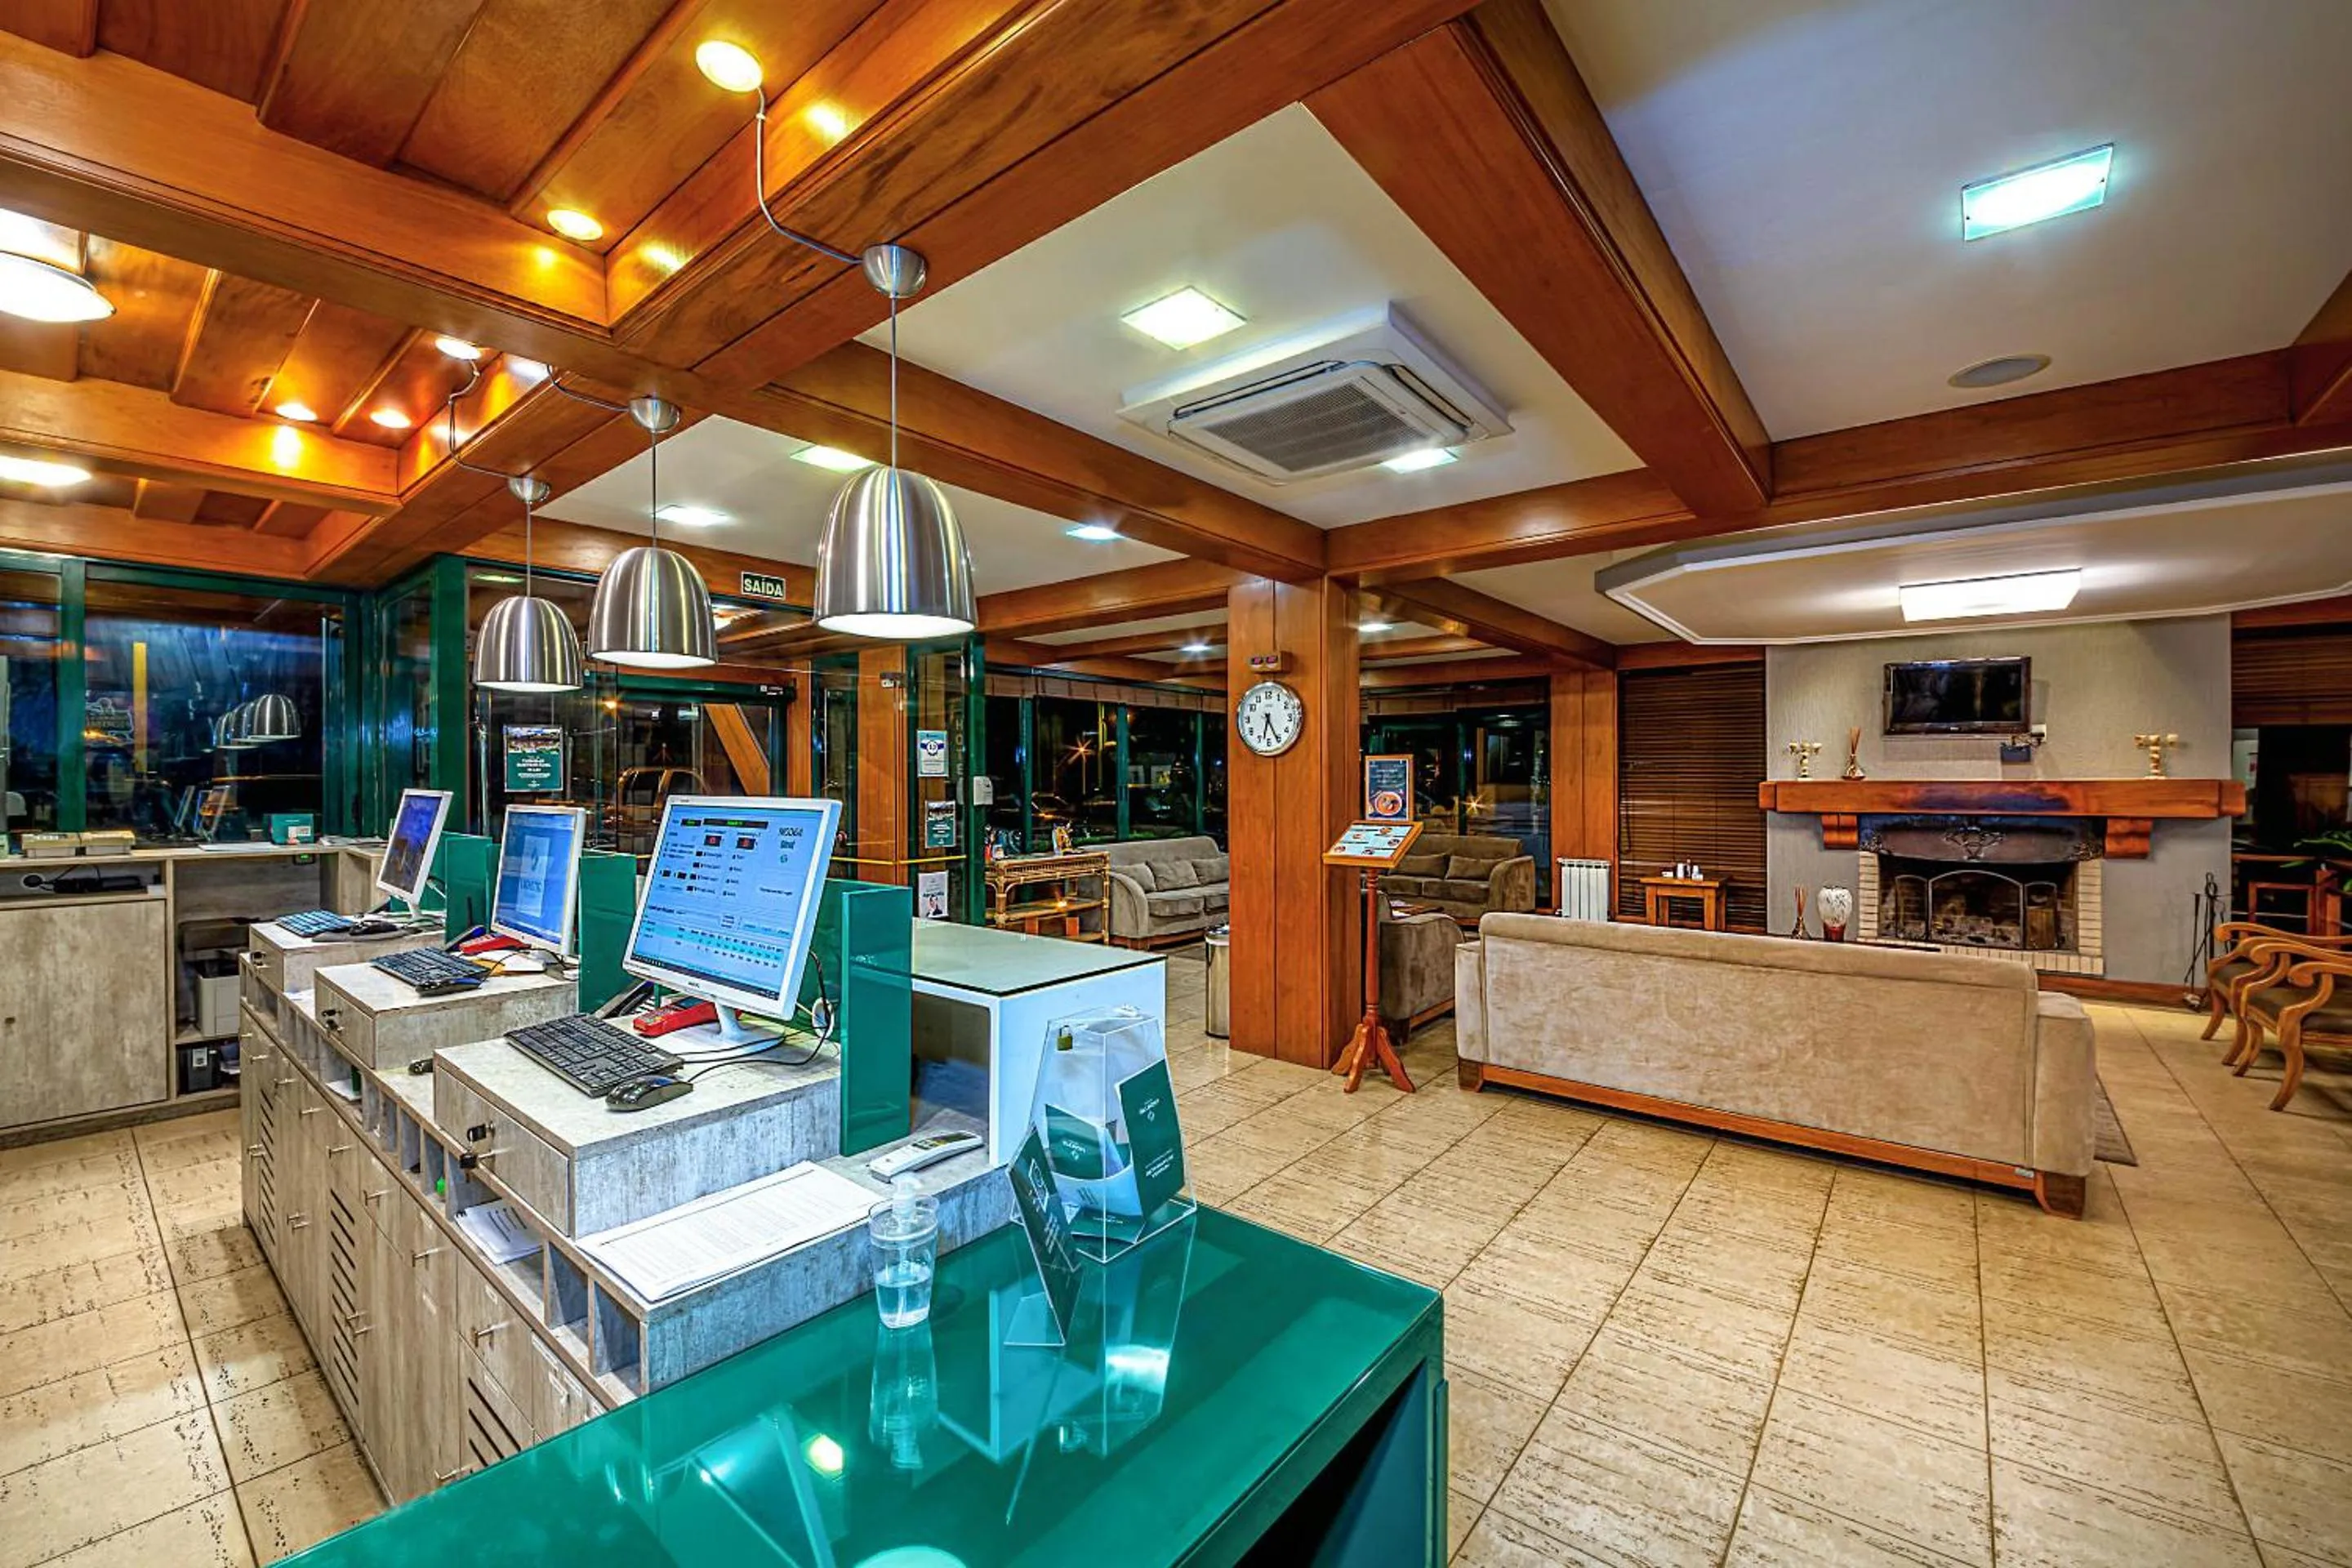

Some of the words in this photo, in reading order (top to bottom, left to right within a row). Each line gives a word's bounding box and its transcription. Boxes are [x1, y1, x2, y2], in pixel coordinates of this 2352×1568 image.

[744, 578, 783, 596] SAÍDA
[1265, 691, 1272, 700] 12
[1250, 704, 1256, 712] 10
[1284, 702, 1289, 710] 2
[1245, 715, 1250, 724] 9
[1287, 713, 1293, 722] 3
[1249, 727, 1254, 736] 8
[1258, 735, 1262, 743] 7
[1267, 738, 1272, 746] 6
[1276, 734, 1281, 743] 5
